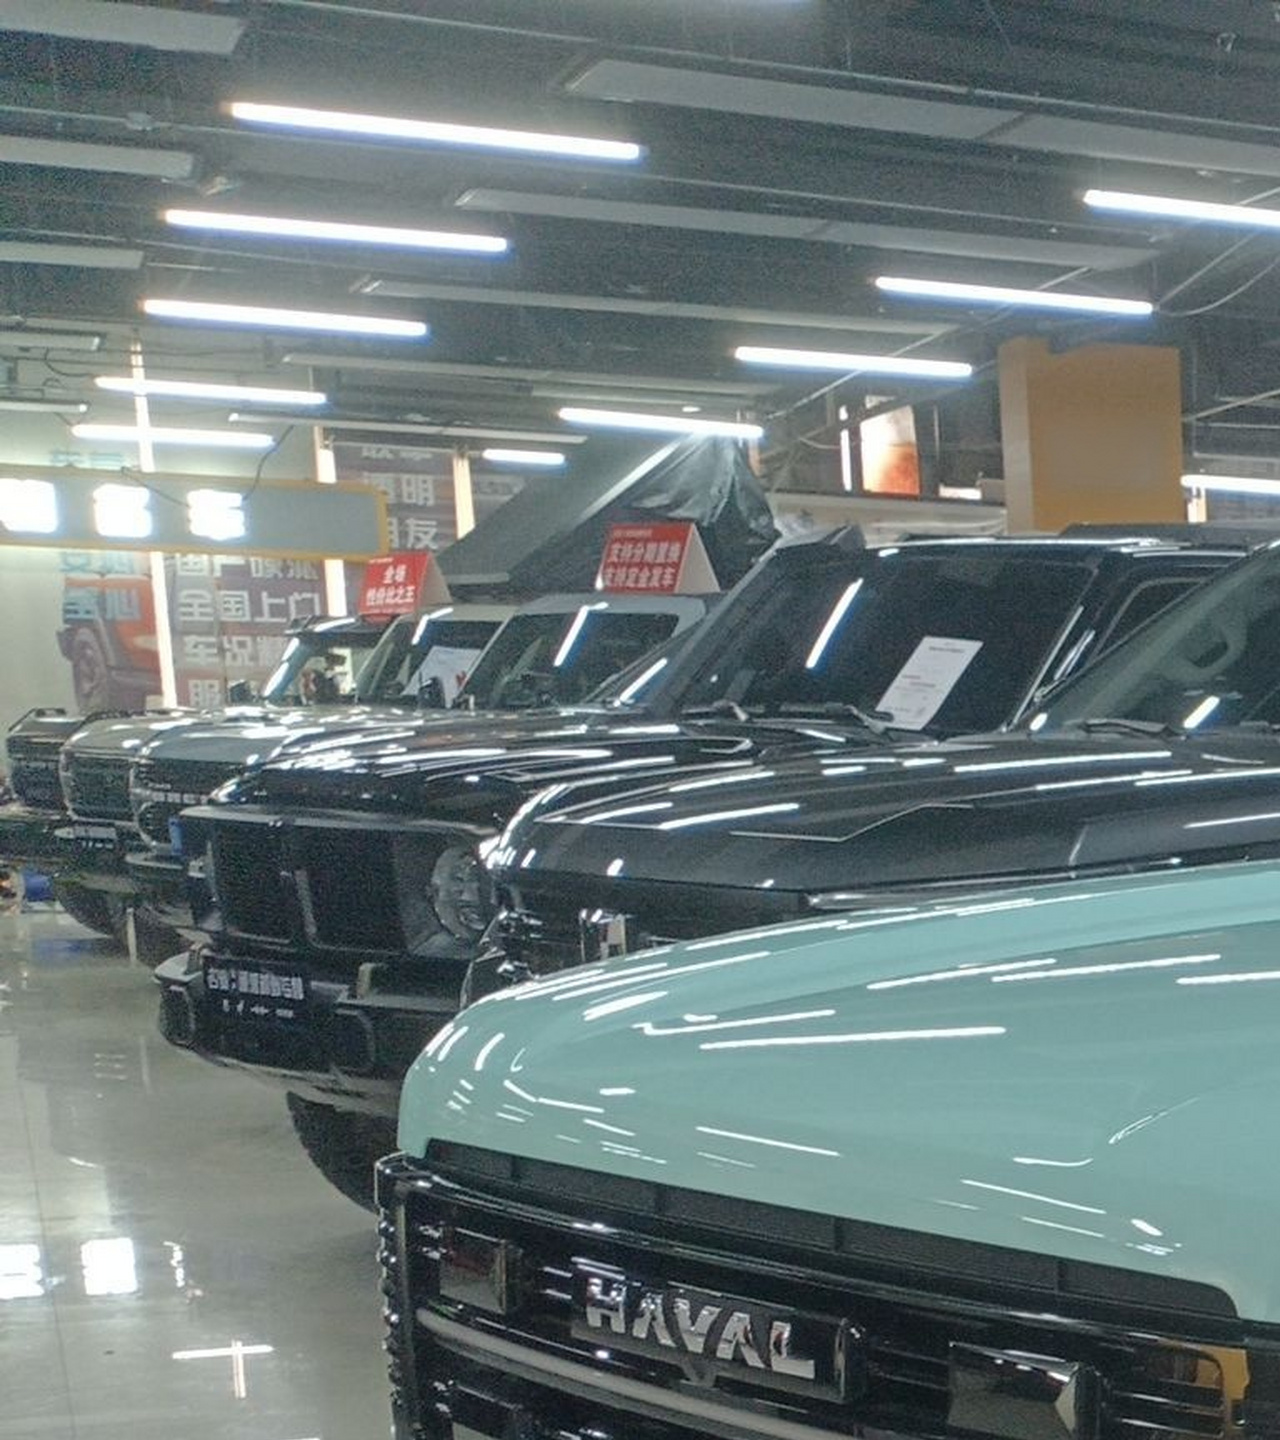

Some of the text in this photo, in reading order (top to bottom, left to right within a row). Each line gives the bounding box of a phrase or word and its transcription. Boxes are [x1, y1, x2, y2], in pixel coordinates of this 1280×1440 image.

[179, 588, 322, 623] 全国上门
[587, 1278, 815, 1380] HAVAL
